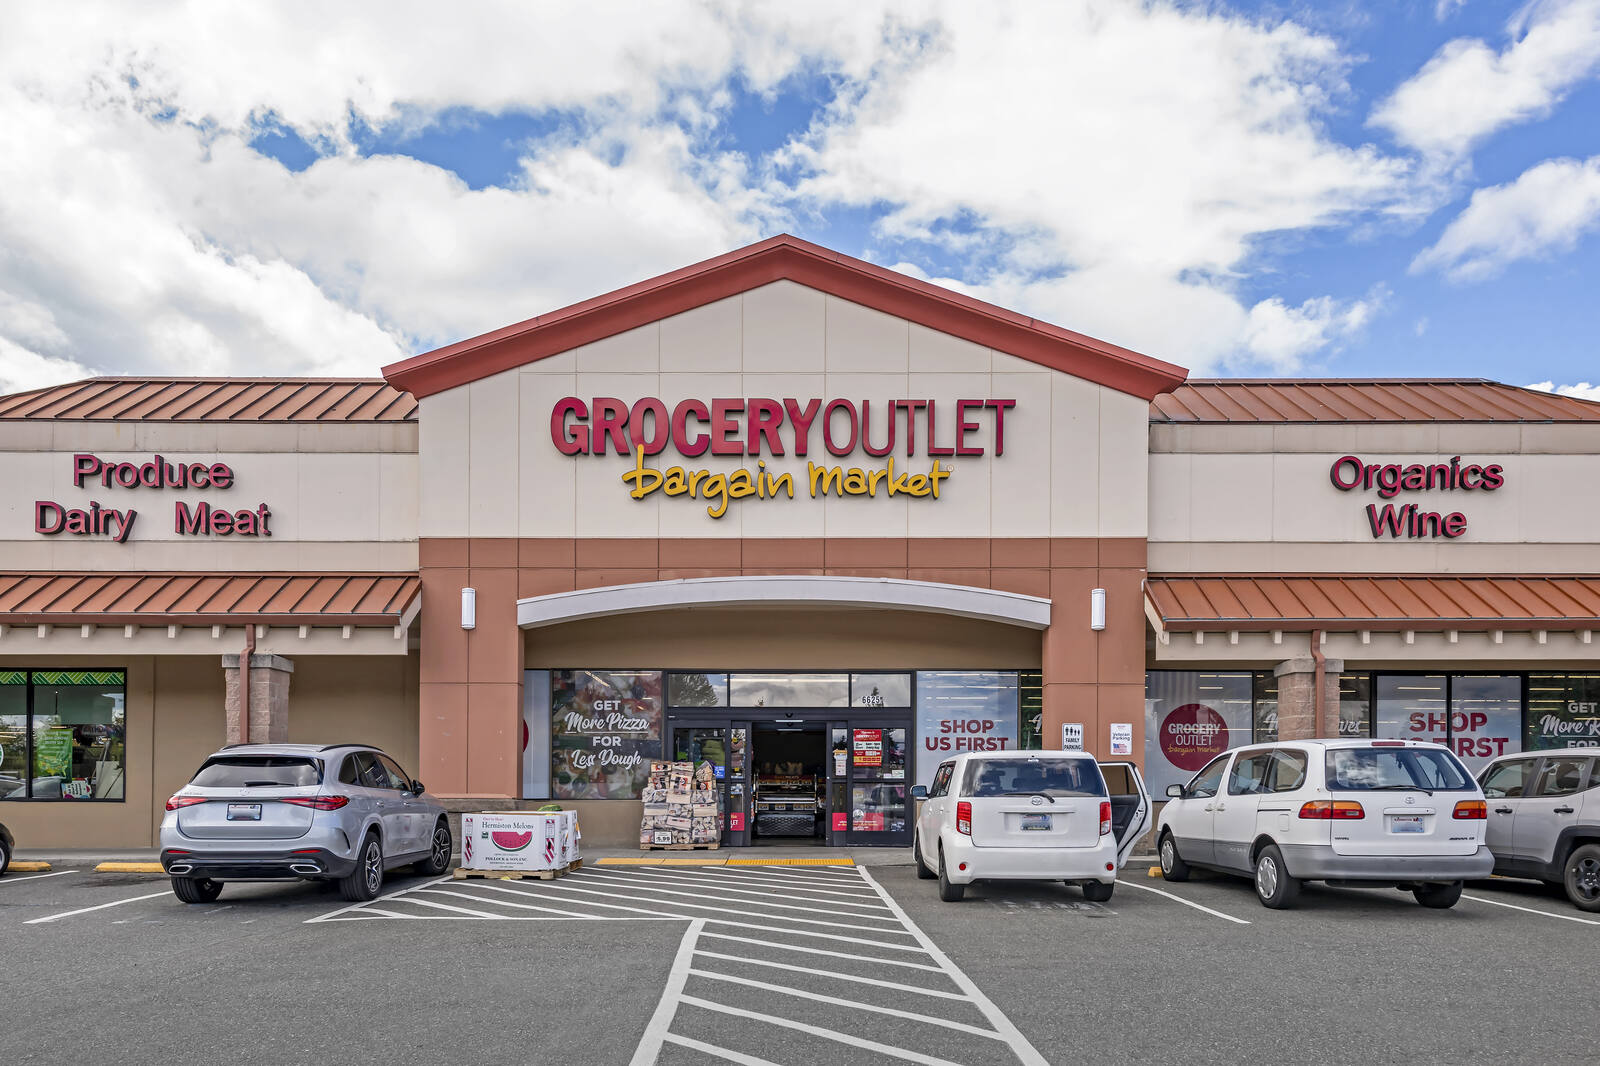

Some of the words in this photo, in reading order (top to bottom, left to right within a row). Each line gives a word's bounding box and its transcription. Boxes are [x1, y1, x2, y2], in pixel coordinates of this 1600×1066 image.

[73, 454, 234, 489] Produce
[622, 444, 793, 519] bargain
[1330, 456, 1504, 499] Organics
[35, 501, 137, 543] Dairy
[175, 501, 272, 536] Meat
[1366, 504, 1467, 538] Wine
[593, 700, 621, 711] GET
[1567, 702, 1598, 713] GET
[564, 711, 605, 733] More
[606, 712, 650, 731] Pizza
[940, 719, 994, 734] SHOP
[1168, 723, 1221, 735] GROCERY
[1409, 712, 1488, 732] SHOP
[1539, 714, 1583, 736] More
[592, 735, 622, 747] FOR
[925, 736, 952, 751] US
[955, 737, 1009, 751] FIRST
[1175, 735, 1213, 746] OUTLET
[598, 749, 642, 770] Dough
